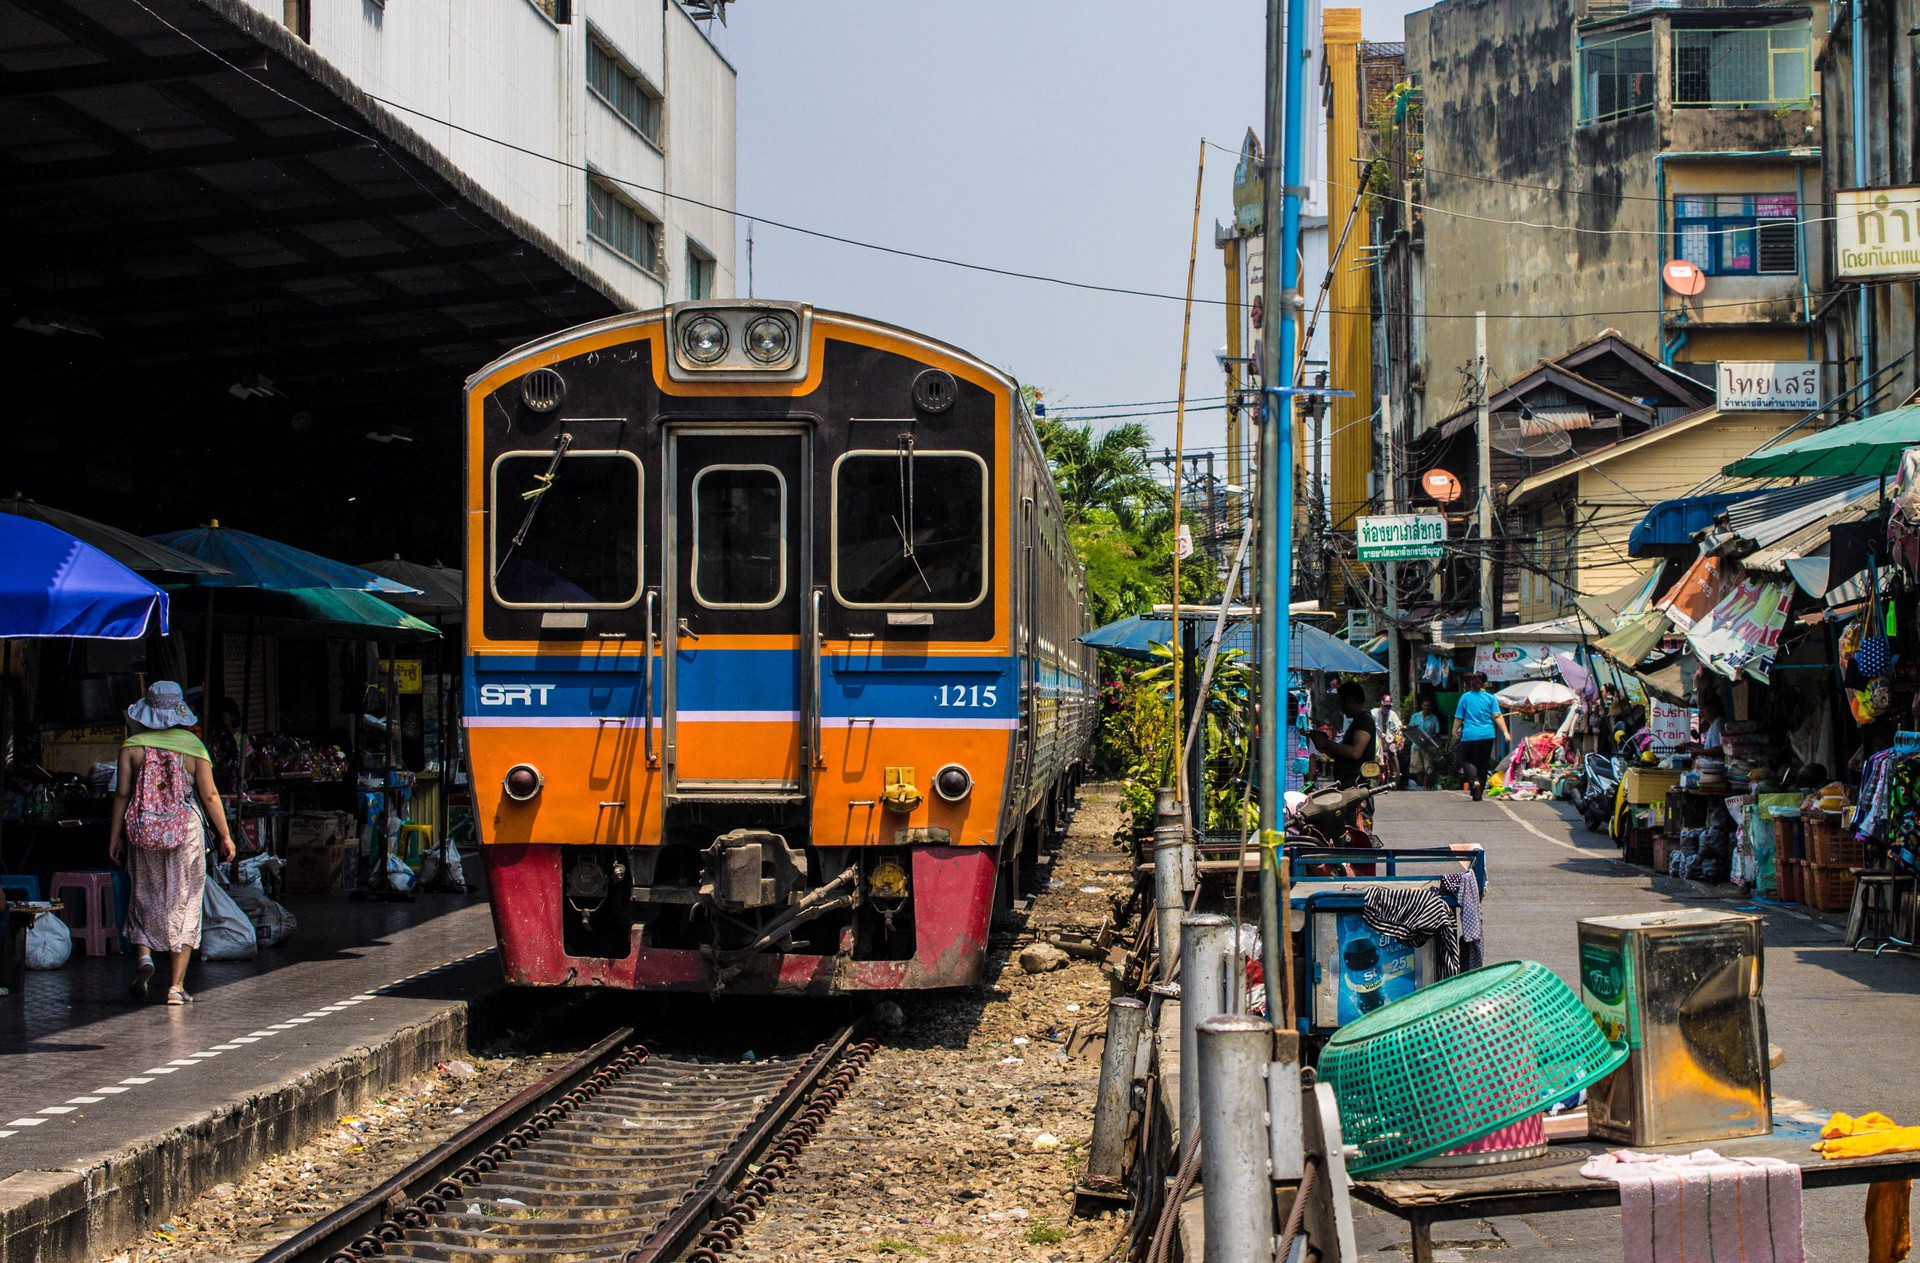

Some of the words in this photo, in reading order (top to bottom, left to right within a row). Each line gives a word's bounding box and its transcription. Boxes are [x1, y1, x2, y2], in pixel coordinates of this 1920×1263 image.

[1723, 368, 1816, 395] ไทยเสรี
[1724, 397, 1818, 408] จำหน่ายสินค้านานาชนิด
[1362, 516, 1442, 543] ห้องยาเภสัชกร
[480, 684, 557, 706] SRT
[938, 684, 997, 708] 1215
[1652, 706, 1689, 718] Sushi
[1655, 730, 1687, 740] Train
